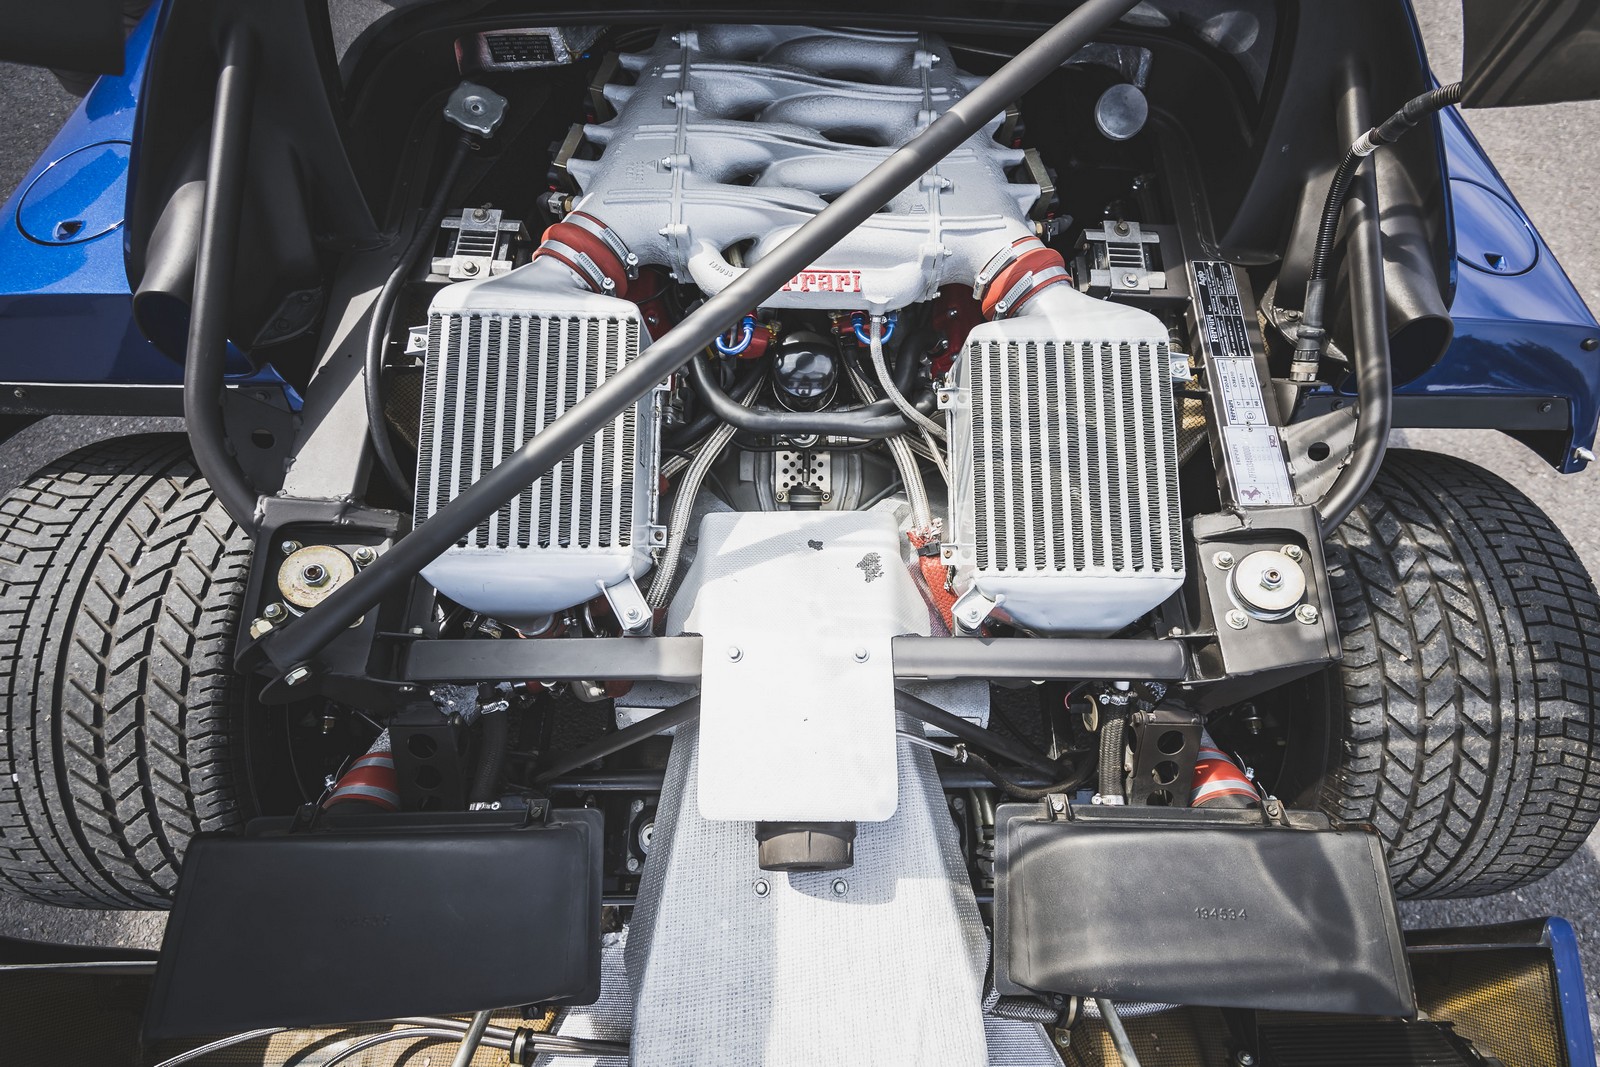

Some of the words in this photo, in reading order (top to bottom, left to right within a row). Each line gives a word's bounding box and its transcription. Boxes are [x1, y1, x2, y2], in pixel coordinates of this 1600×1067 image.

[782, 269, 861, 292] rrari
[1197, 270, 1206, 286] Agip
[1206, 314, 1219, 343] Ferrari
[1228, 399, 1236, 420] Ferrari
[1233, 443, 1241, 466] Ferrari
[1194, 907, 1248, 921] 134534
